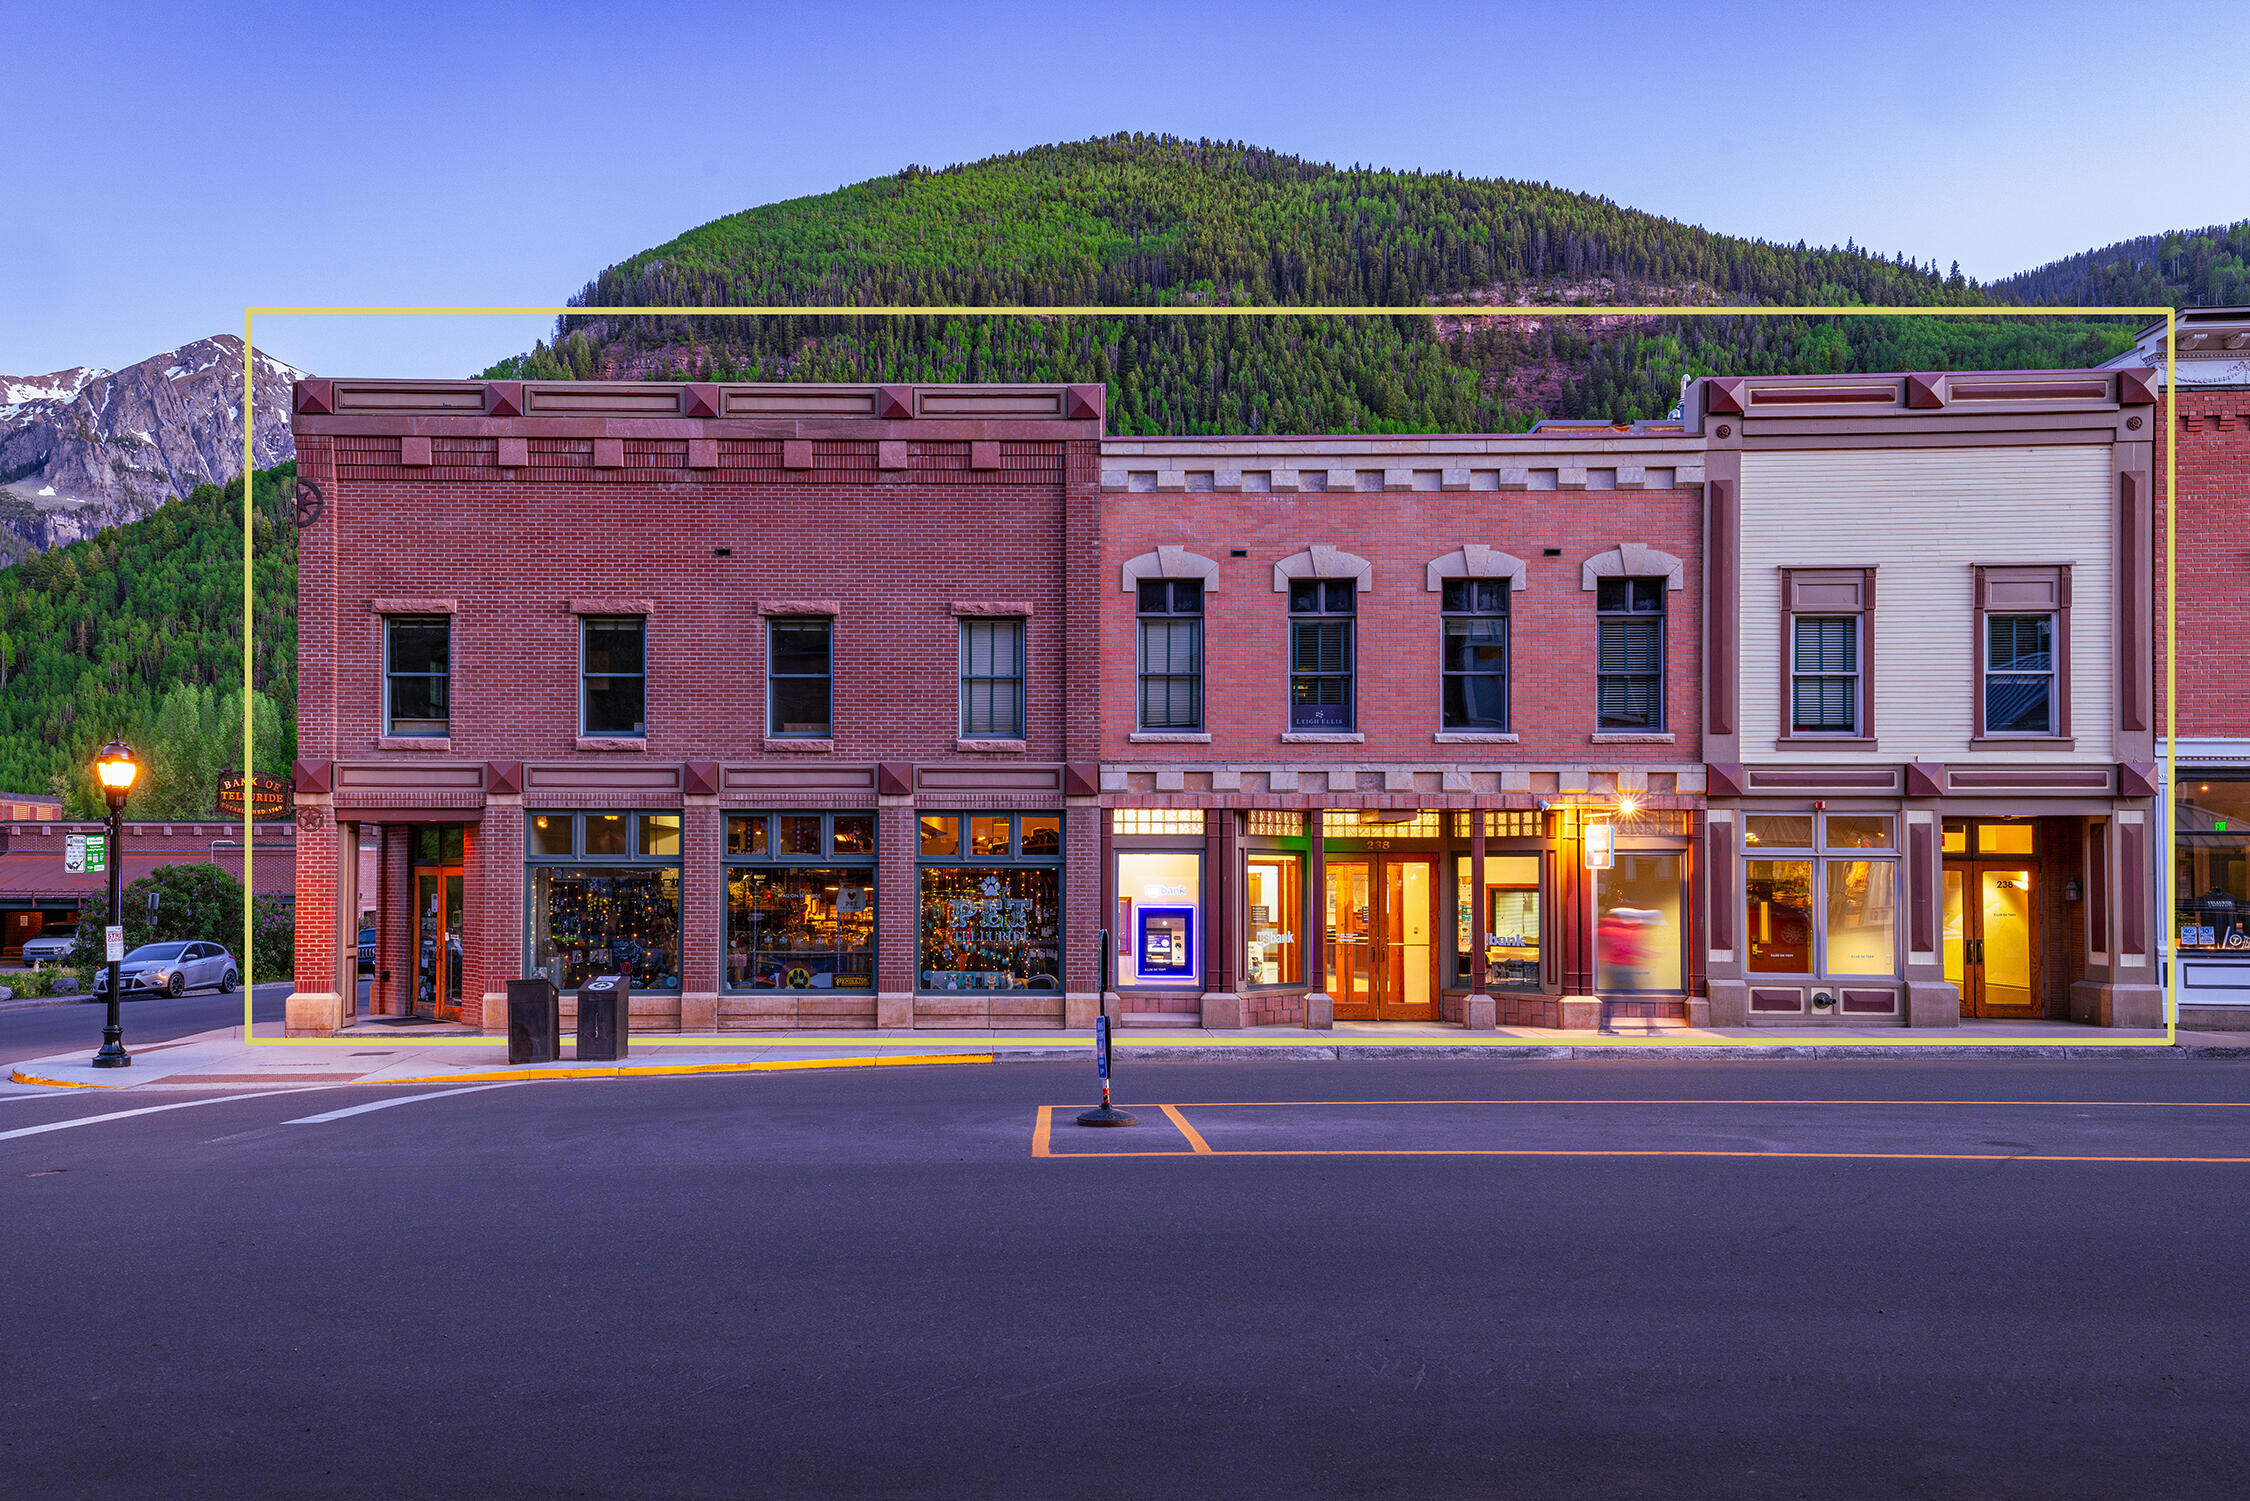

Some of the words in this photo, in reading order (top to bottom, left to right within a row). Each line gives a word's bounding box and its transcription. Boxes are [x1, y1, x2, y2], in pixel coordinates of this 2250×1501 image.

[265, 780, 281, 793] OF
[1996, 880, 2014, 889] 238
[949, 898, 1033, 928] PET
[953, 930, 1032, 942] TELLURIDE
